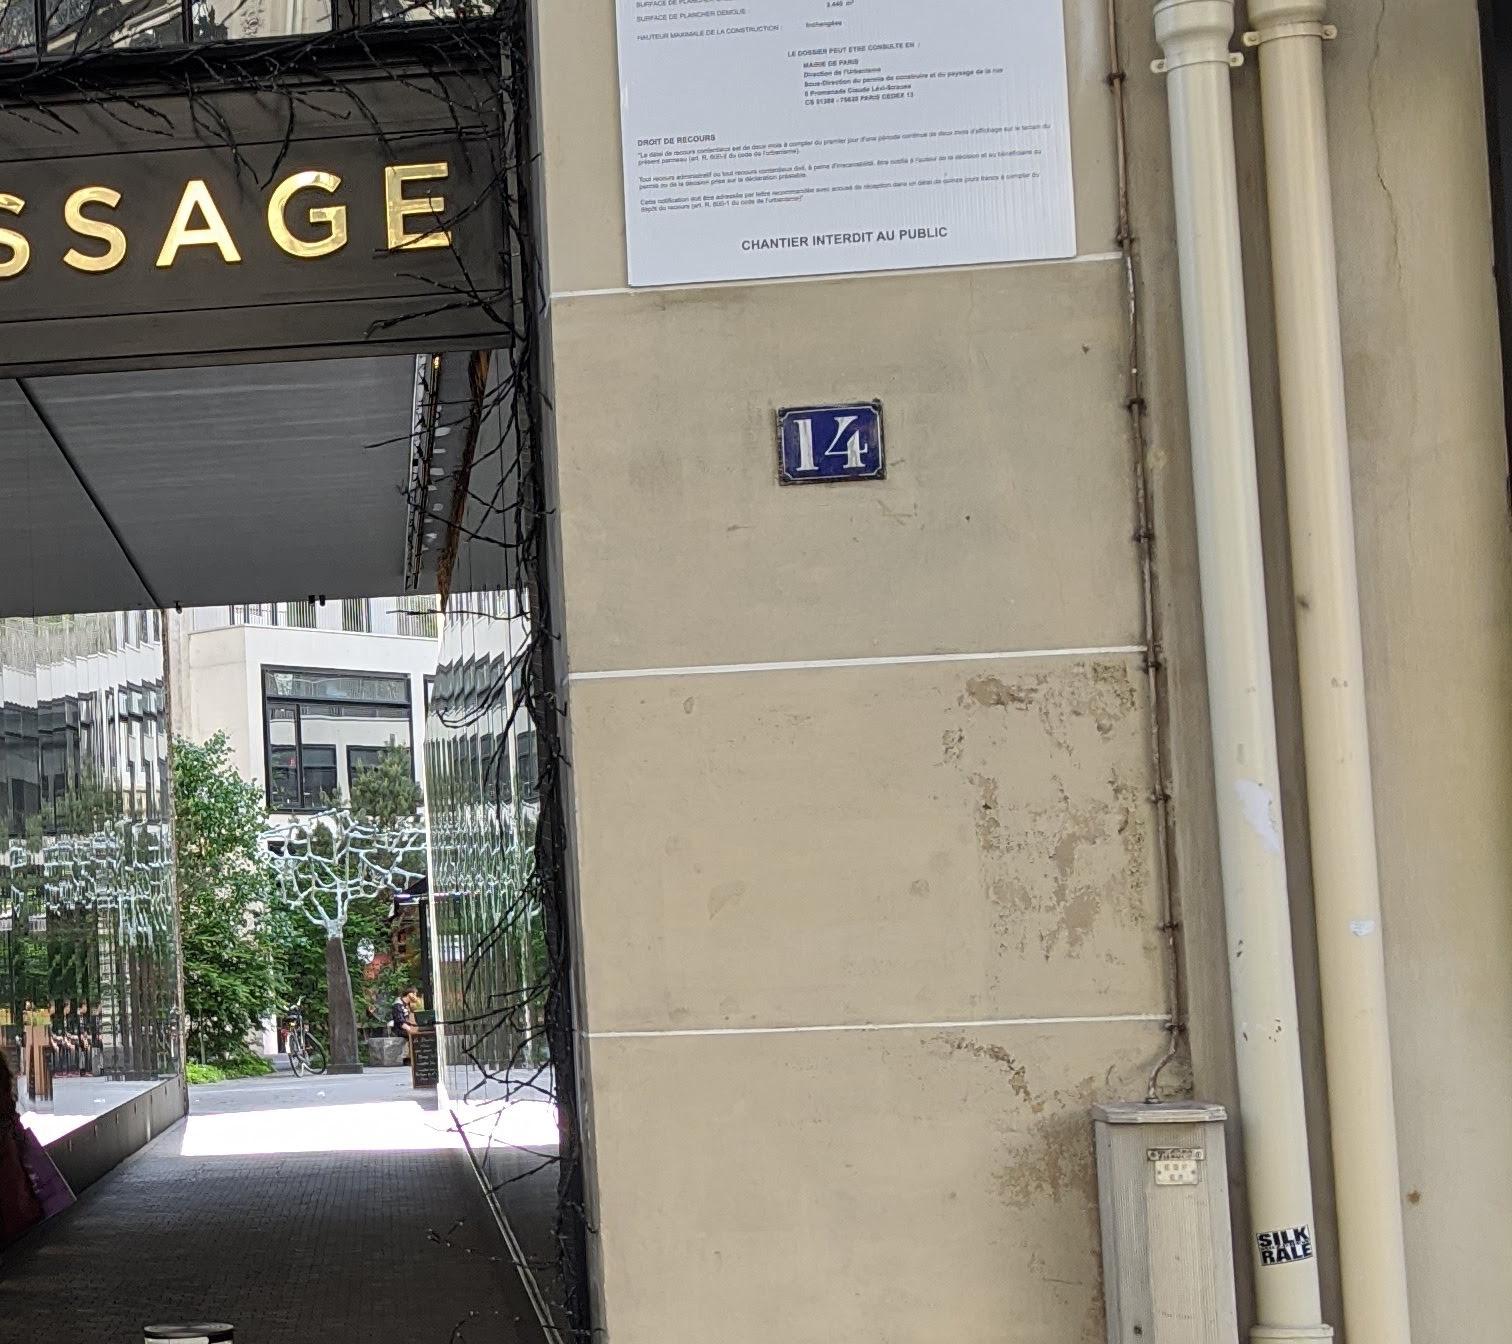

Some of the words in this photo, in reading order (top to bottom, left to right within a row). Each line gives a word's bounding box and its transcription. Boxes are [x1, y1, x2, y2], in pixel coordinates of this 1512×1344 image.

[637, 137, 661, 146] DROIT
[663, 137, 674, 145] DE
[676, 134, 715, 144] RECOURS
[741, 236, 808, 250] CHANTIER
[812, 232, 873, 245] INTERDIT
[876, 230, 894, 241] AU
[899, 227, 947, 239] PUBLIC
[793, 415, 868, 471] 14
[1258, 1226, 1309, 1247] SILK
[1260, 1244, 1312, 1264] RALE
